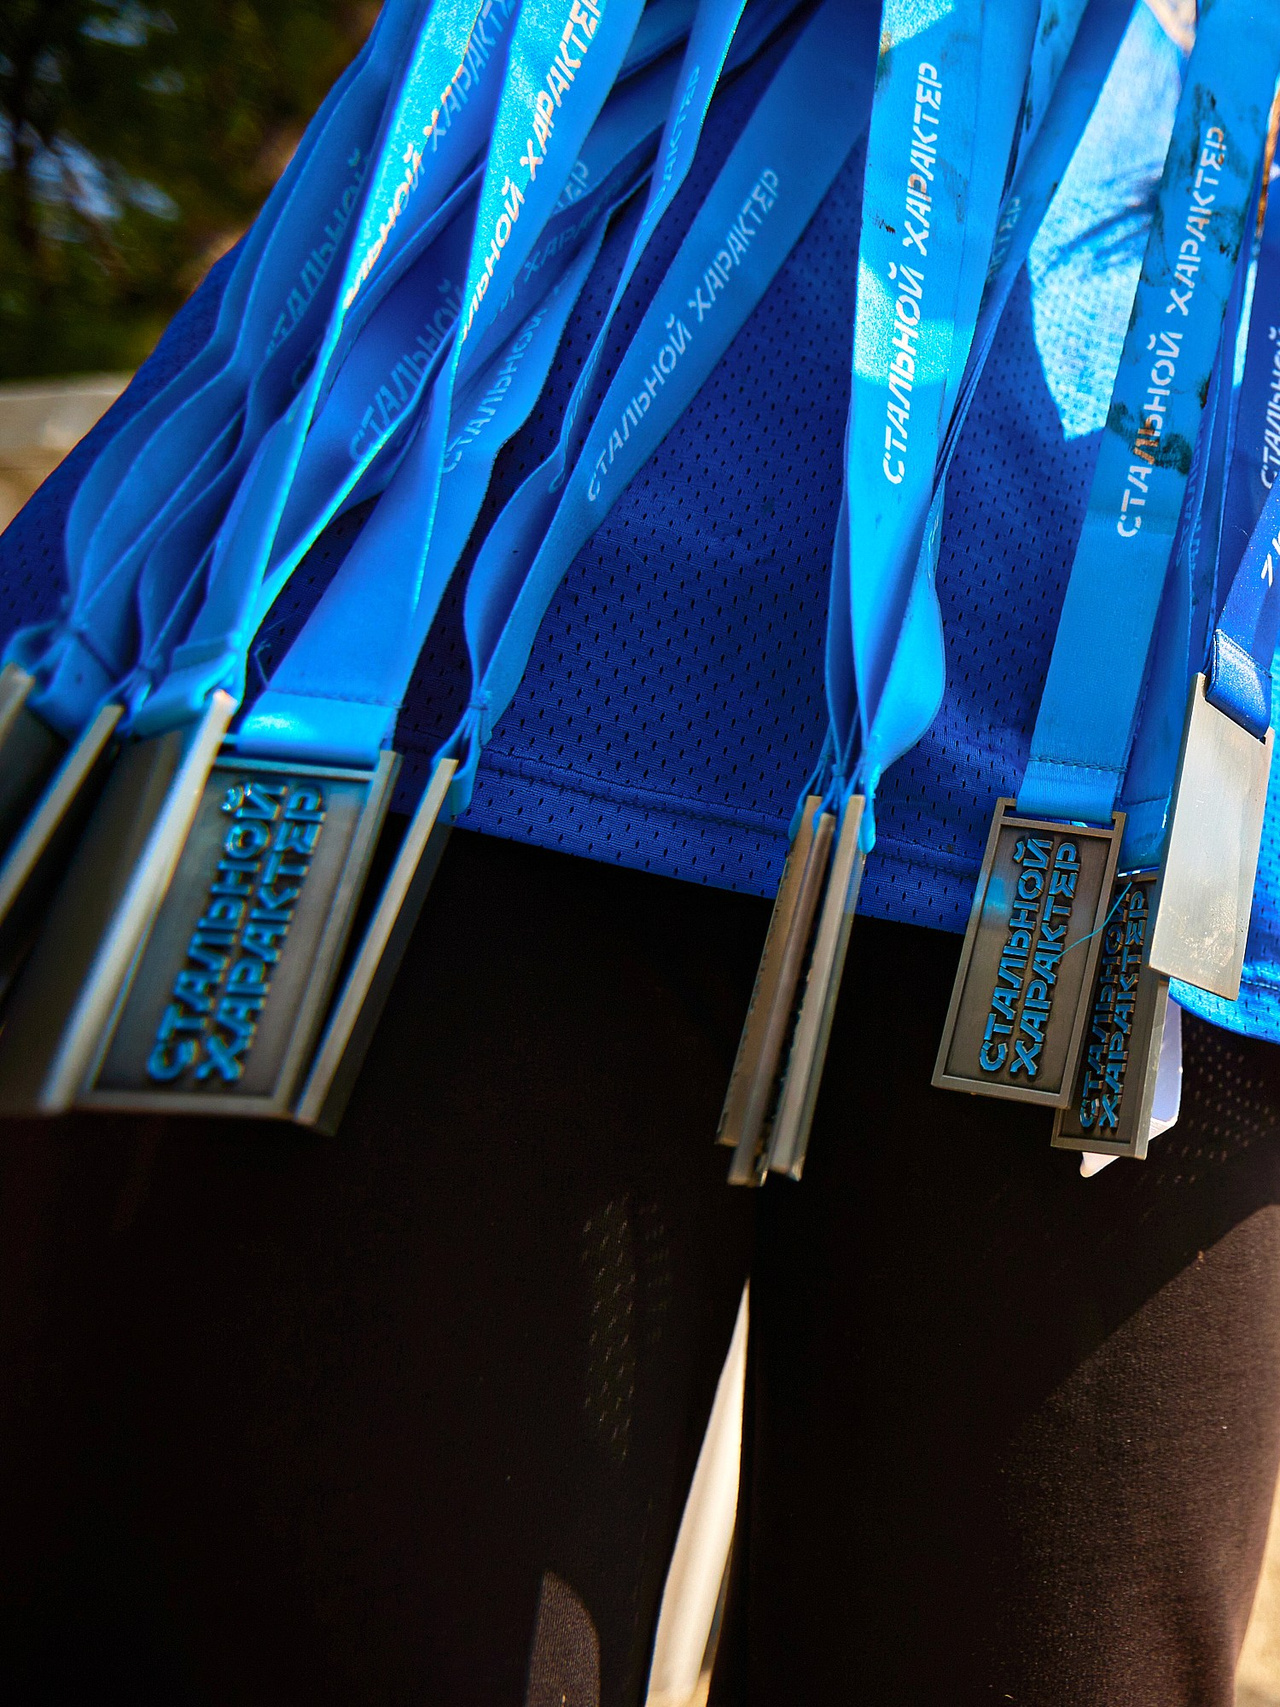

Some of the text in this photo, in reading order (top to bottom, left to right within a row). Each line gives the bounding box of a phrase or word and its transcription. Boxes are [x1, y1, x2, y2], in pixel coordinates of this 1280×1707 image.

[587, 168, 780, 502] СТАЛЬНОЙ ХАРАКТЕР
[883, 62, 943, 485] СТАЛЬНОЙ ХАРАКТЕР
[1117, 127, 1227, 537] СТАЛЬНОЙ ХАРАКТЕР
[147, 782, 288, 1081] СТАЛЬНОЙ
[196, 786, 327, 1081] ХАРАКТЕР
[980, 838, 1053, 1072] СТАЛЬНОЙ
[1010, 842, 1080, 1076] ХАРАКТЕР
[1080, 888, 1131, 1128] СТАЛЬНОЙ
[1099, 890, 1149, 1128] ХАРАКТЕР
